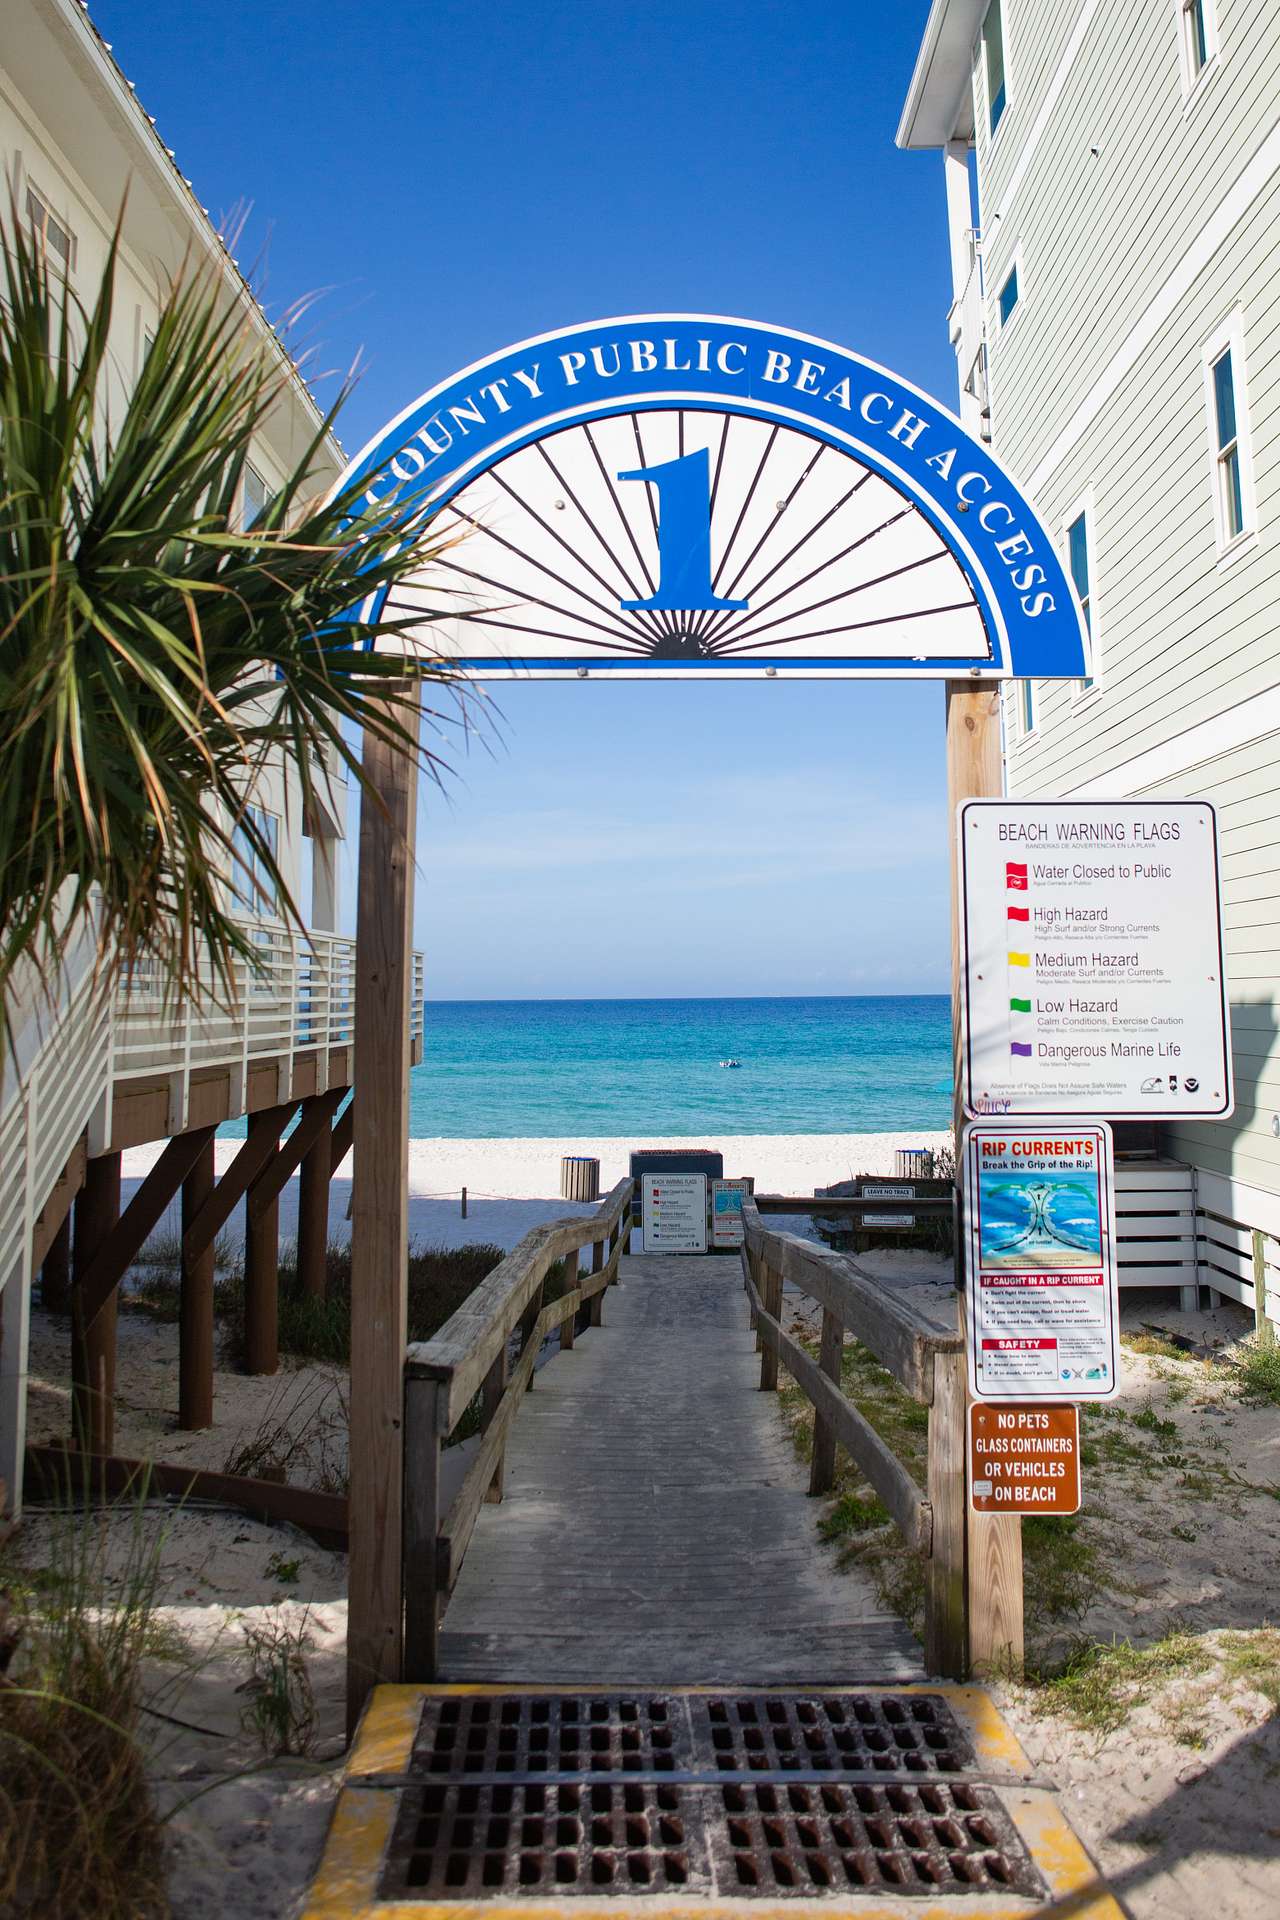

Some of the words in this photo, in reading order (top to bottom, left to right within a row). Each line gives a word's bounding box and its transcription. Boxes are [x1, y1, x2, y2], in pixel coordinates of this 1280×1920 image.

[558, 338, 748, 386] PUBLIC
[760, 349, 931, 451] BEACH
[925, 448, 1057, 618] ACCESS
[617, 446, 749, 610] 1
[999, 823, 1048, 841] BEACH
[1056, 823, 1125, 841] WARNING
[1133, 823, 1181, 841] FLAGS
[1032, 864, 1069, 878] Water
[1072, 864, 1114, 878] Closed
[1119, 864, 1130, 878] to
[1134, 864, 1172, 878] Public
[1034, 907, 1061, 924] High
[1065, 907, 1108, 921] Hazard
[1034, 924, 1052, 934] High
[1054, 924, 1070, 932] Surf
[1072, 924, 1097, 932] and/or
[1099, 924, 1125, 933] Strong
[1126, 924, 1160, 932] Currents
[1035, 953, 1087, 967] Medium
[1091, 953, 1139, 967] Hazard
[1036, 968, 1076, 977] Moderate
[1078, 968, 1096, 977] Surf
[1098, 968, 1125, 977] and/or
[1127, 968, 1164, 977] Currents
[1037, 999, 1065, 1013] Low
[1069, 999, 1118, 1013] Hazard
[1037, 1017, 1059, 1026] Calm
[1112, 1017, 1148, 1026] Exercise
[1150, 1017, 1183, 1026] Caution
[1038, 1043, 1107, 1061] Dangerous
[1111, 1042, 1154, 1057] Marine
[1158, 1042, 1181, 1057] Life
[982, 1142, 1007, 1156] RIP
[1012, 1141, 1094, 1155] CURRENTS
[982, 1160, 1008, 1169] Break
[1011, 1160, 1025, 1169] the
[1027, 1161, 1046, 1170] Grip
[1048, 1160, 1057, 1169] of
[1060, 1160, 1074, 1169] the
[1076, 1160, 1093, 1169] Rip!
[984, 1277, 992, 1286] IF
[993, 1277, 1027, 1285] CAUGHT
[1028, 1276, 1037, 1285] IN
[1039, 1276, 1045, 1284] A
[1047, 1276, 1060, 1284] RIP
[1062, 1276, 1100, 1284] CURRENT
[998, 1341, 1040, 1349] SAFETY
[998, 1414, 1015, 1428] NO
[1018, 1414, 1049, 1428] PETS
[976, 1438, 1008, 1453] GLASS
[1010, 1438, 1073, 1453] CONTAINERS
[985, 1462, 1001, 1477] OR
[1005, 1462, 1065, 1477] VEHICLES
[995, 1486, 1012, 1501] ON
[1015, 1486, 1056, 1501] BEACH
